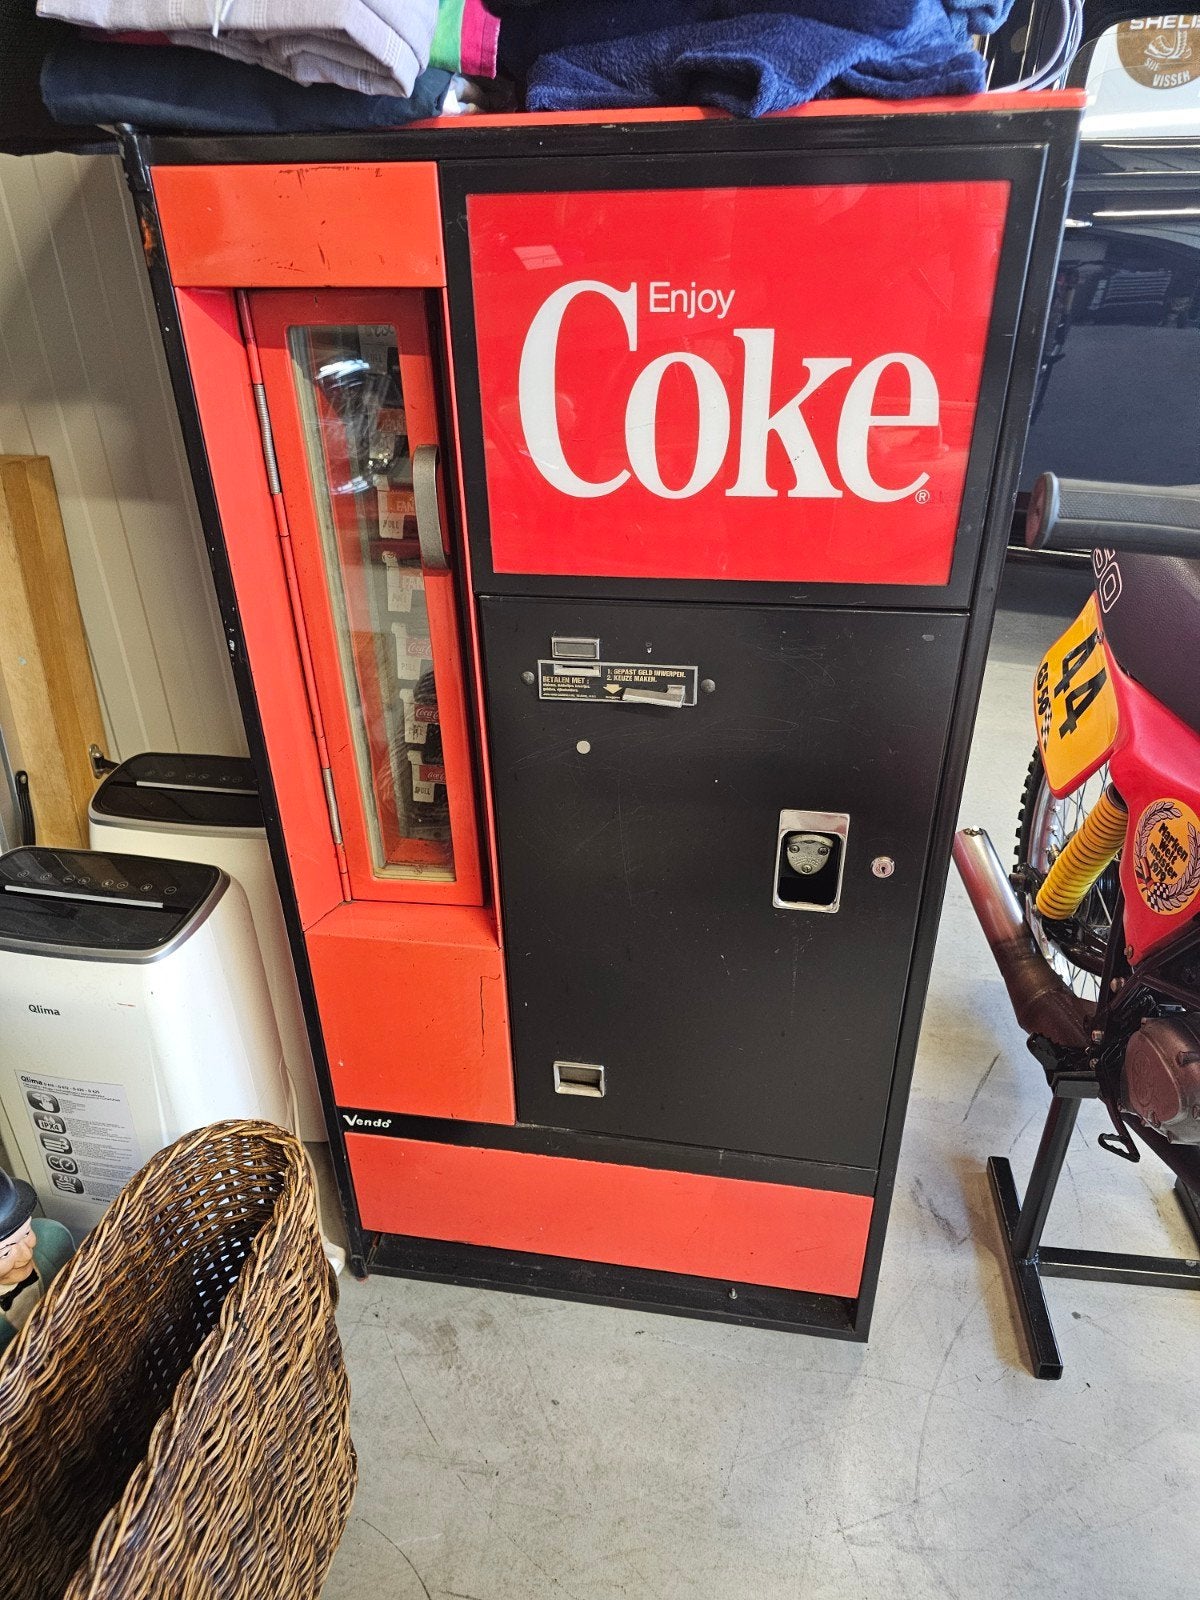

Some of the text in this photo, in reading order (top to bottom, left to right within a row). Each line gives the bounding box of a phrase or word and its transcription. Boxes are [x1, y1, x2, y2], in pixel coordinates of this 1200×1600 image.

[649, 281, 736, 319] Enjoy
[518, 279, 940, 503] Coke
[542, 675, 570, 684] BETALEN
[613, 668, 636, 676] GEPAST
[1054, 628, 1108, 740] 44
[28, 1004, 61, 1017] Qlima
[342, 1114, 391, 1129] Vendo
